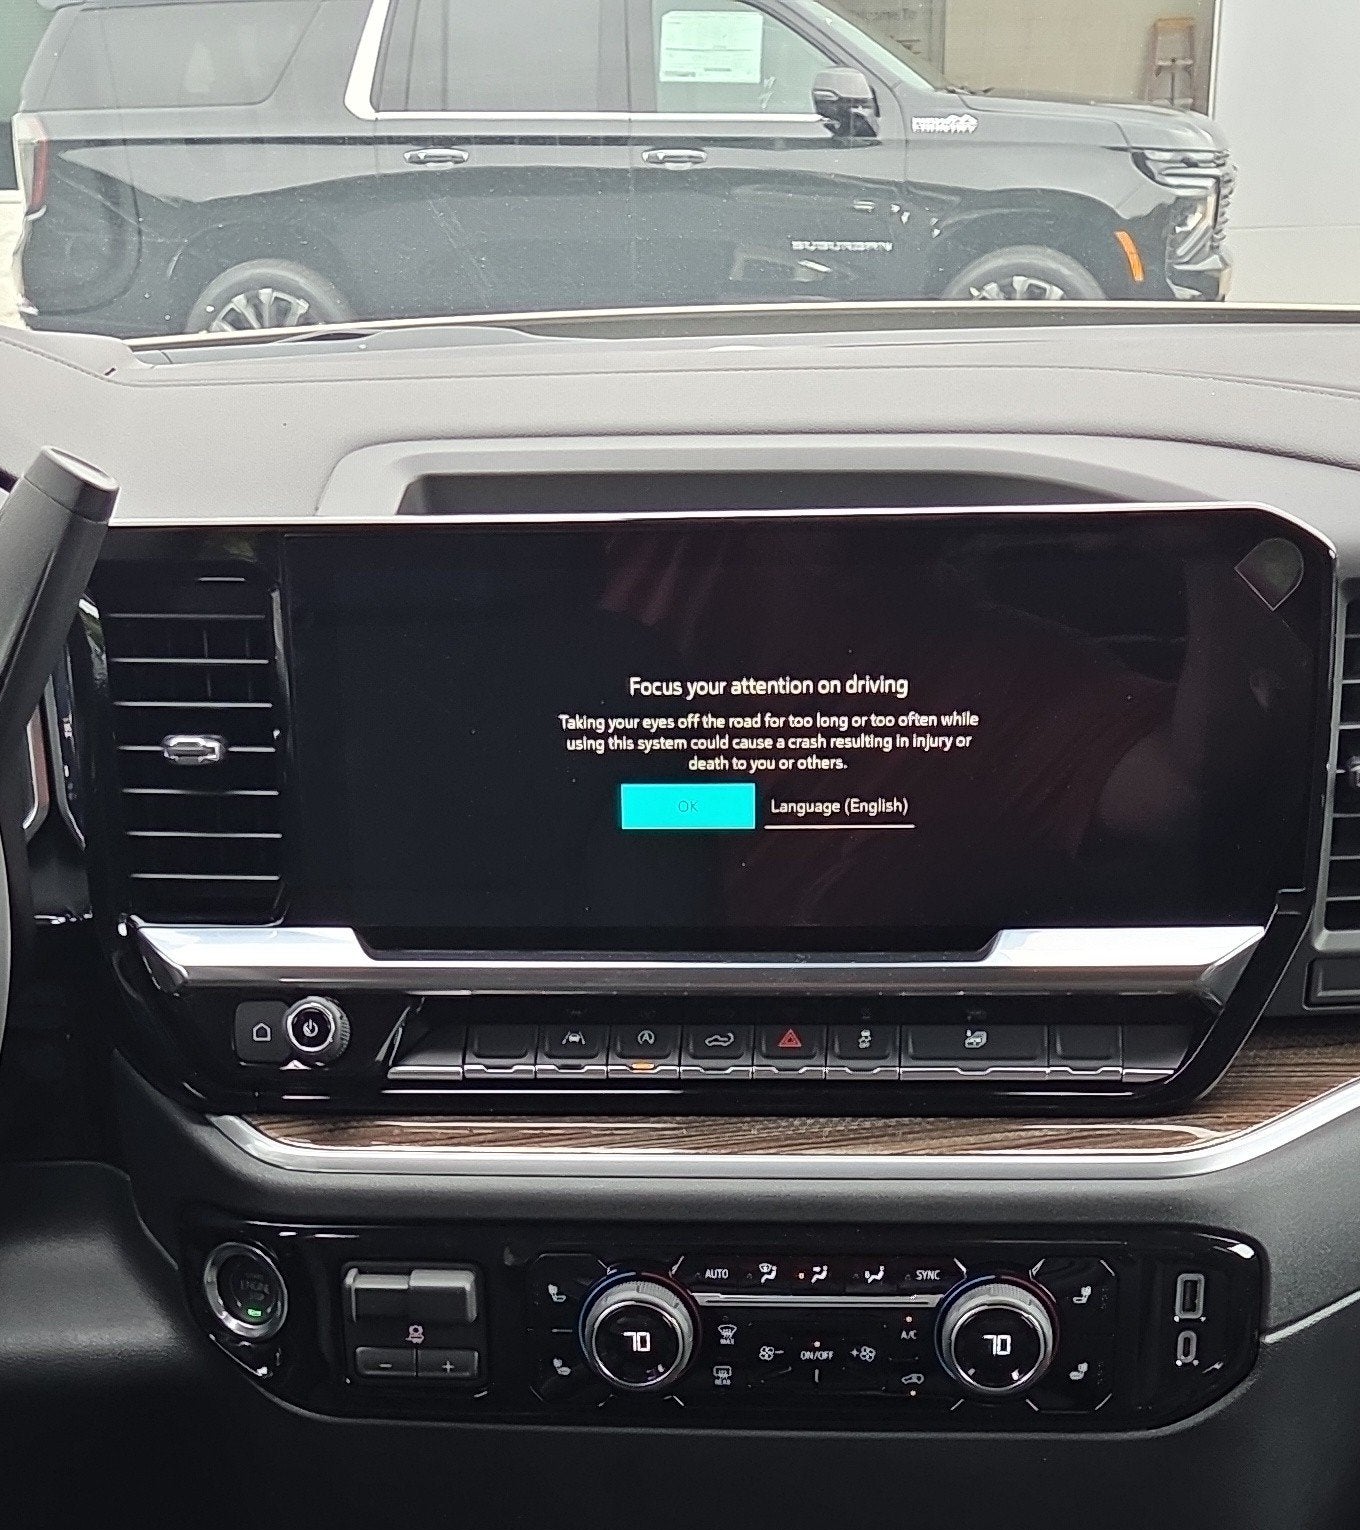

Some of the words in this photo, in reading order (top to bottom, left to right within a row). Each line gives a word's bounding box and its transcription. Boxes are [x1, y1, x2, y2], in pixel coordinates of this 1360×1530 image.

[629, 677, 682, 696] Focus
[686, 680, 727, 700] your
[730, 676, 814, 695] attention
[817, 680, 841, 695] on
[845, 674, 909, 698] driving
[558, 713, 605, 733] Taking
[607, 717, 640, 733] your
[642, 718, 675, 732] eyes
[678, 712, 701, 728] off
[702, 712, 726, 729] the
[729, 712, 761, 728] road
[764, 712, 786, 728] for
[788, 713, 813, 728] too
[816, 711, 849, 731] long
[851, 715, 868, 727] or
[870, 713, 895, 727] too
[898, 711, 938, 727] often
[941, 711, 979, 727] while
[566, 736, 605, 754] using
[608, 735, 634, 750] this
[637, 736, 688, 753] system
[690, 734, 729, 750] could
[732, 736, 774, 749] cause
[776, 737, 785, 749] a
[788, 733, 827, 749] crash
[830, 733, 893, 752] resulting
[896, 733, 909, 748] in
[913, 733, 953, 751] injury
[955, 735, 973, 748] or
[689, 755, 729, 770] death
[732, 757, 747, 770] to
[749, 758, 776, 774] you
[778, 757, 794, 770] or
[797, 754, 848, 770] others.
[678, 800, 699, 813] OK
[770, 799, 841, 817] Language
[844, 798, 909, 817] (English)
[705, 1268, 729, 1279] AUTO
[915, 1270, 941, 1281] SYNC
[621, 1331, 651, 1352] 70
[900, 1330, 918, 1340] A/C
[982, 1334, 1012, 1356] 70
[800, 1350, 834, 1361] ON/OFF
